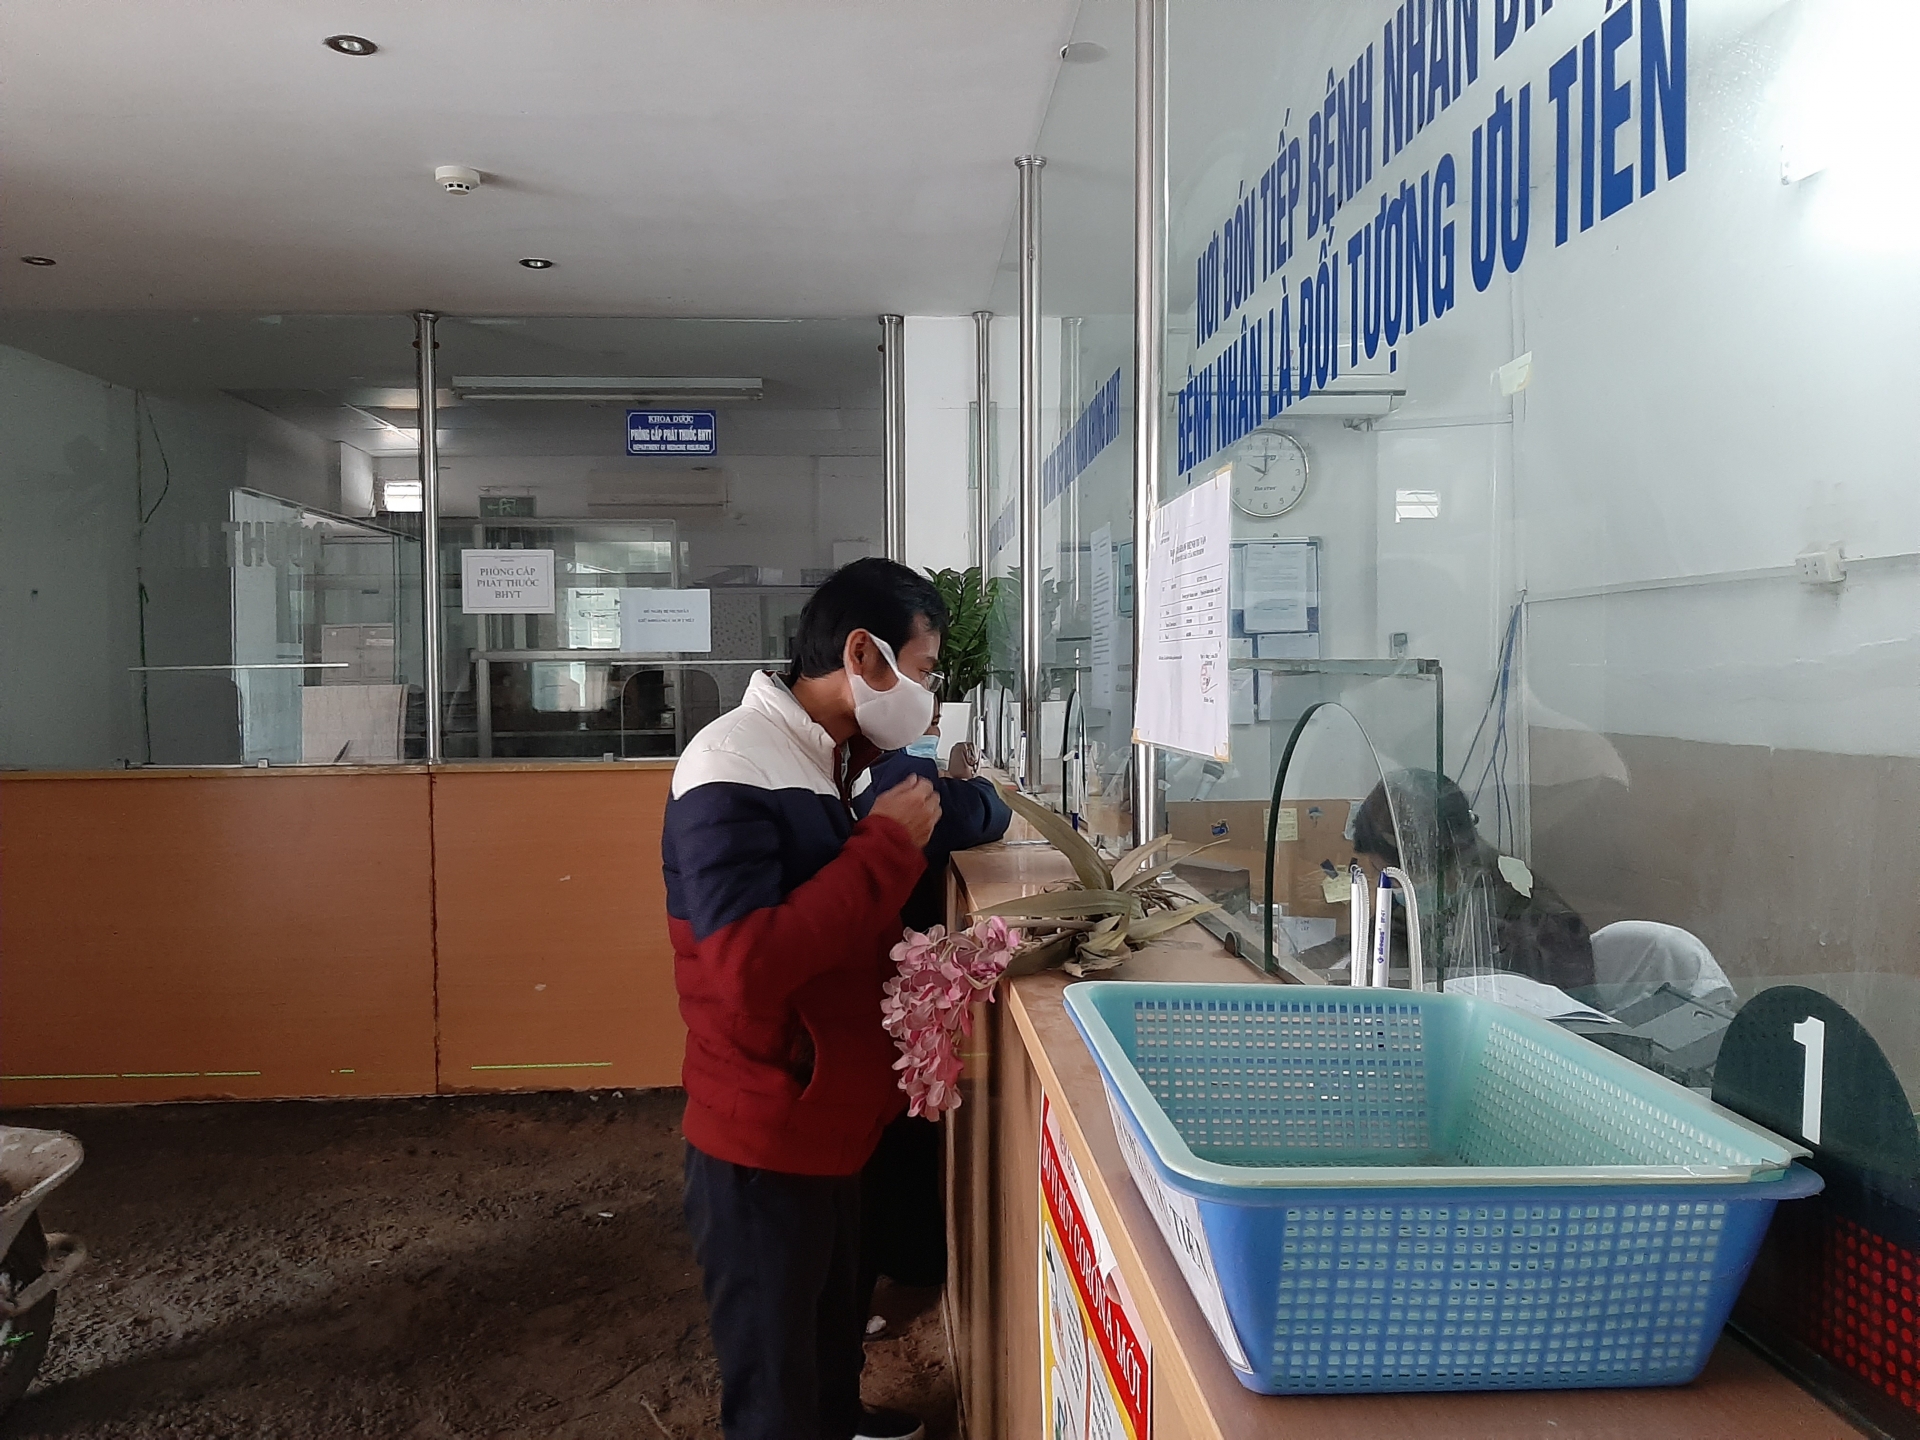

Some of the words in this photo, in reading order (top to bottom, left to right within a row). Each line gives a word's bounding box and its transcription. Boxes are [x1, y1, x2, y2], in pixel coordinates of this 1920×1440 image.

[1196, 230, 1219, 350] NƠI
[1223, 179, 1256, 322] ĐÓN
[1261, 107, 1300, 284] TIẾP
[1307, 42, 1374, 241] BỆNH
[1178, 364, 1212, 486] BỆNH
[1217, 313, 1263, 452] NHÂN
[1268, 274, 1293, 420] LÀ
[1299, 225, 1339, 401] ĐỐI
[1347, 152, 1456, 374] TƯỢNG
[1471, 81, 1531, 292] ƯU
[648, 415, 671, 424] KHOA
[673, 414, 694, 425] DƯỢC
[480, 565, 515, 576] PHÒNG
[516, 565, 536, 576] CẤP
[495, 590, 522, 599] BHYT
[505, 577, 539, 588] THUỐC
[1793, 1016, 1825, 1146] 1
[1074, 1223, 1115, 1350] CORONA
